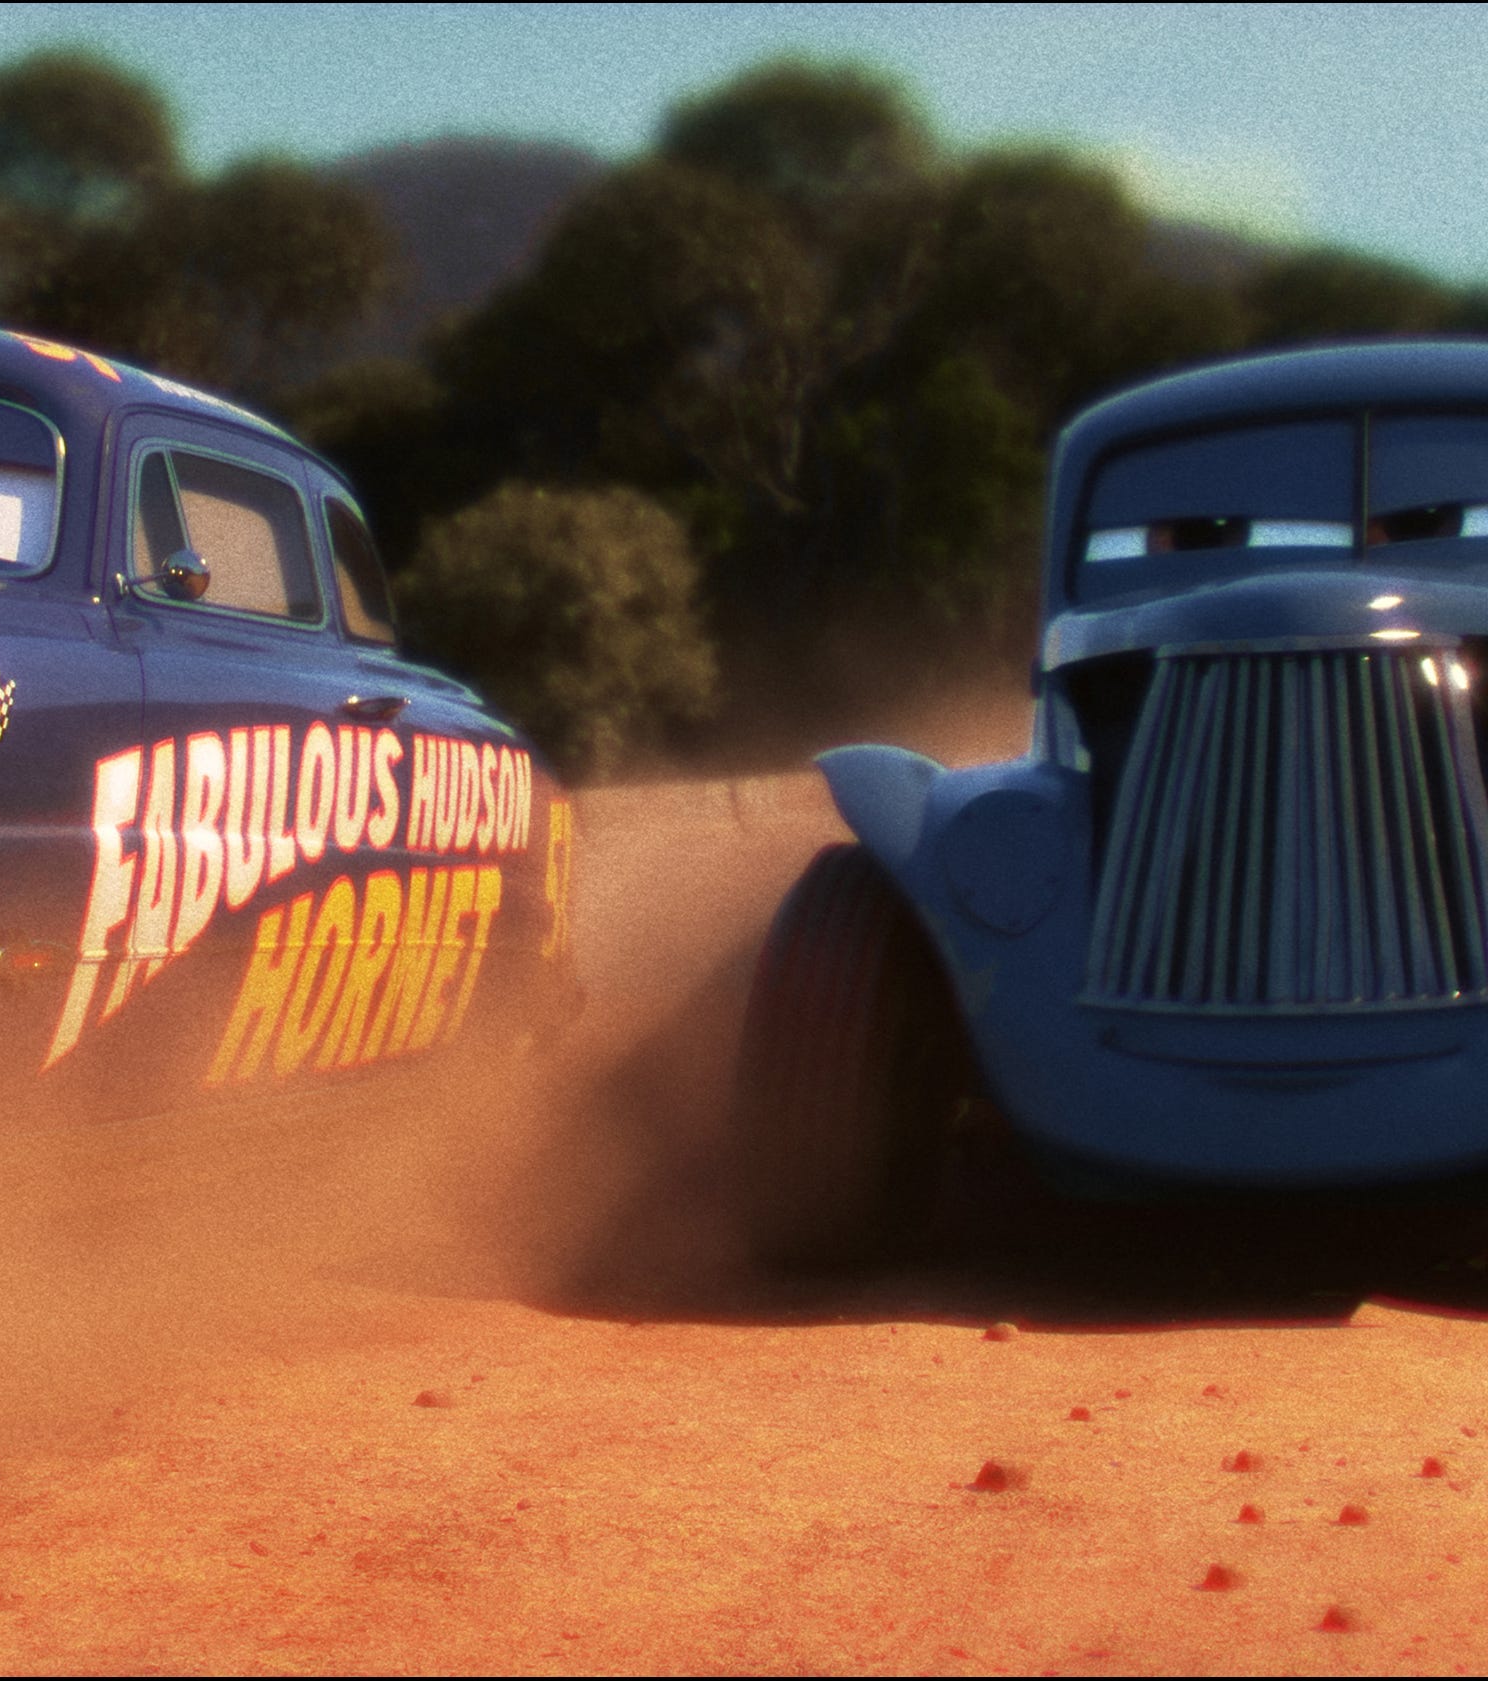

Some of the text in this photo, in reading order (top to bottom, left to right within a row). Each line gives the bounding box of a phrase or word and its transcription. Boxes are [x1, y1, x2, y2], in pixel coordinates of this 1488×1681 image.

[39, 721, 532, 1074] FABULOUS HUDSON
[208, 866, 502, 1086] HORNET
